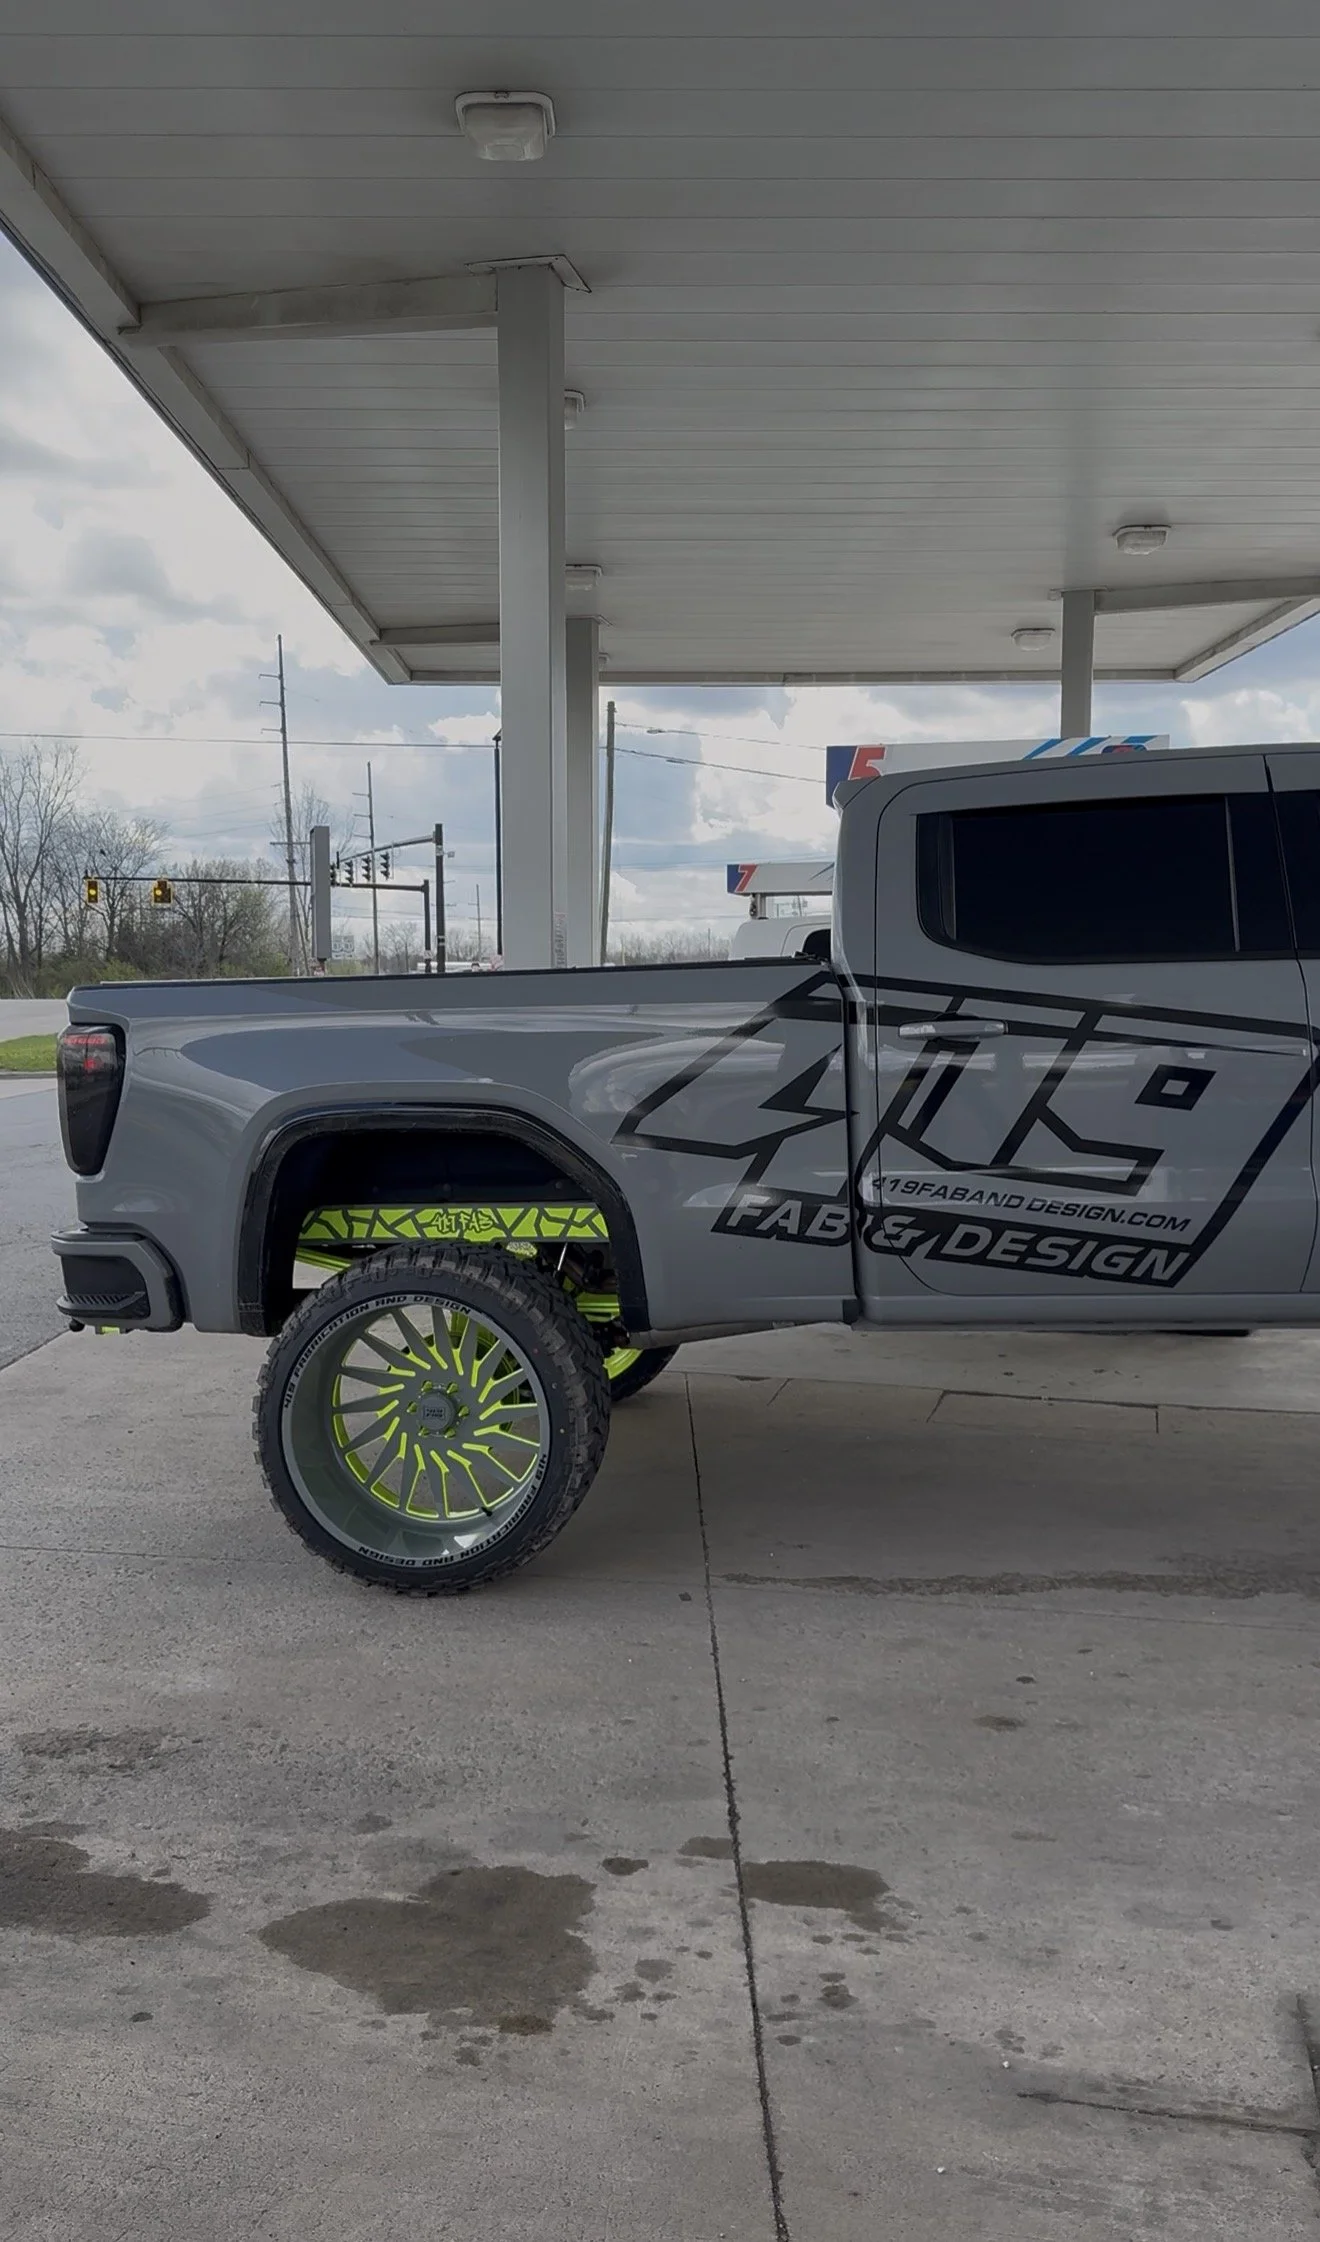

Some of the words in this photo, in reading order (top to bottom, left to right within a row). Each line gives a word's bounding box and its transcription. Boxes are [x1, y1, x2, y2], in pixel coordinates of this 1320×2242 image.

[848, 745, 885, 780] 5
[735, 864, 758, 892] 7
[726, 1194, 850, 1239] FAB
[940, 1223, 1190, 1281] DESIGN
[284, 1383, 295, 1408] 419
[294, 1304, 370, 1379] FABRICATION
[376, 1296, 407, 1307] AND
[414, 1295, 471, 1315] DESIGN
[535, 1453, 547, 1481] 419
[460, 1486, 537, 1559] FABRICATION
[358, 1546, 416, 1567] DESIGN
[422, 1556, 454, 1566] AND
